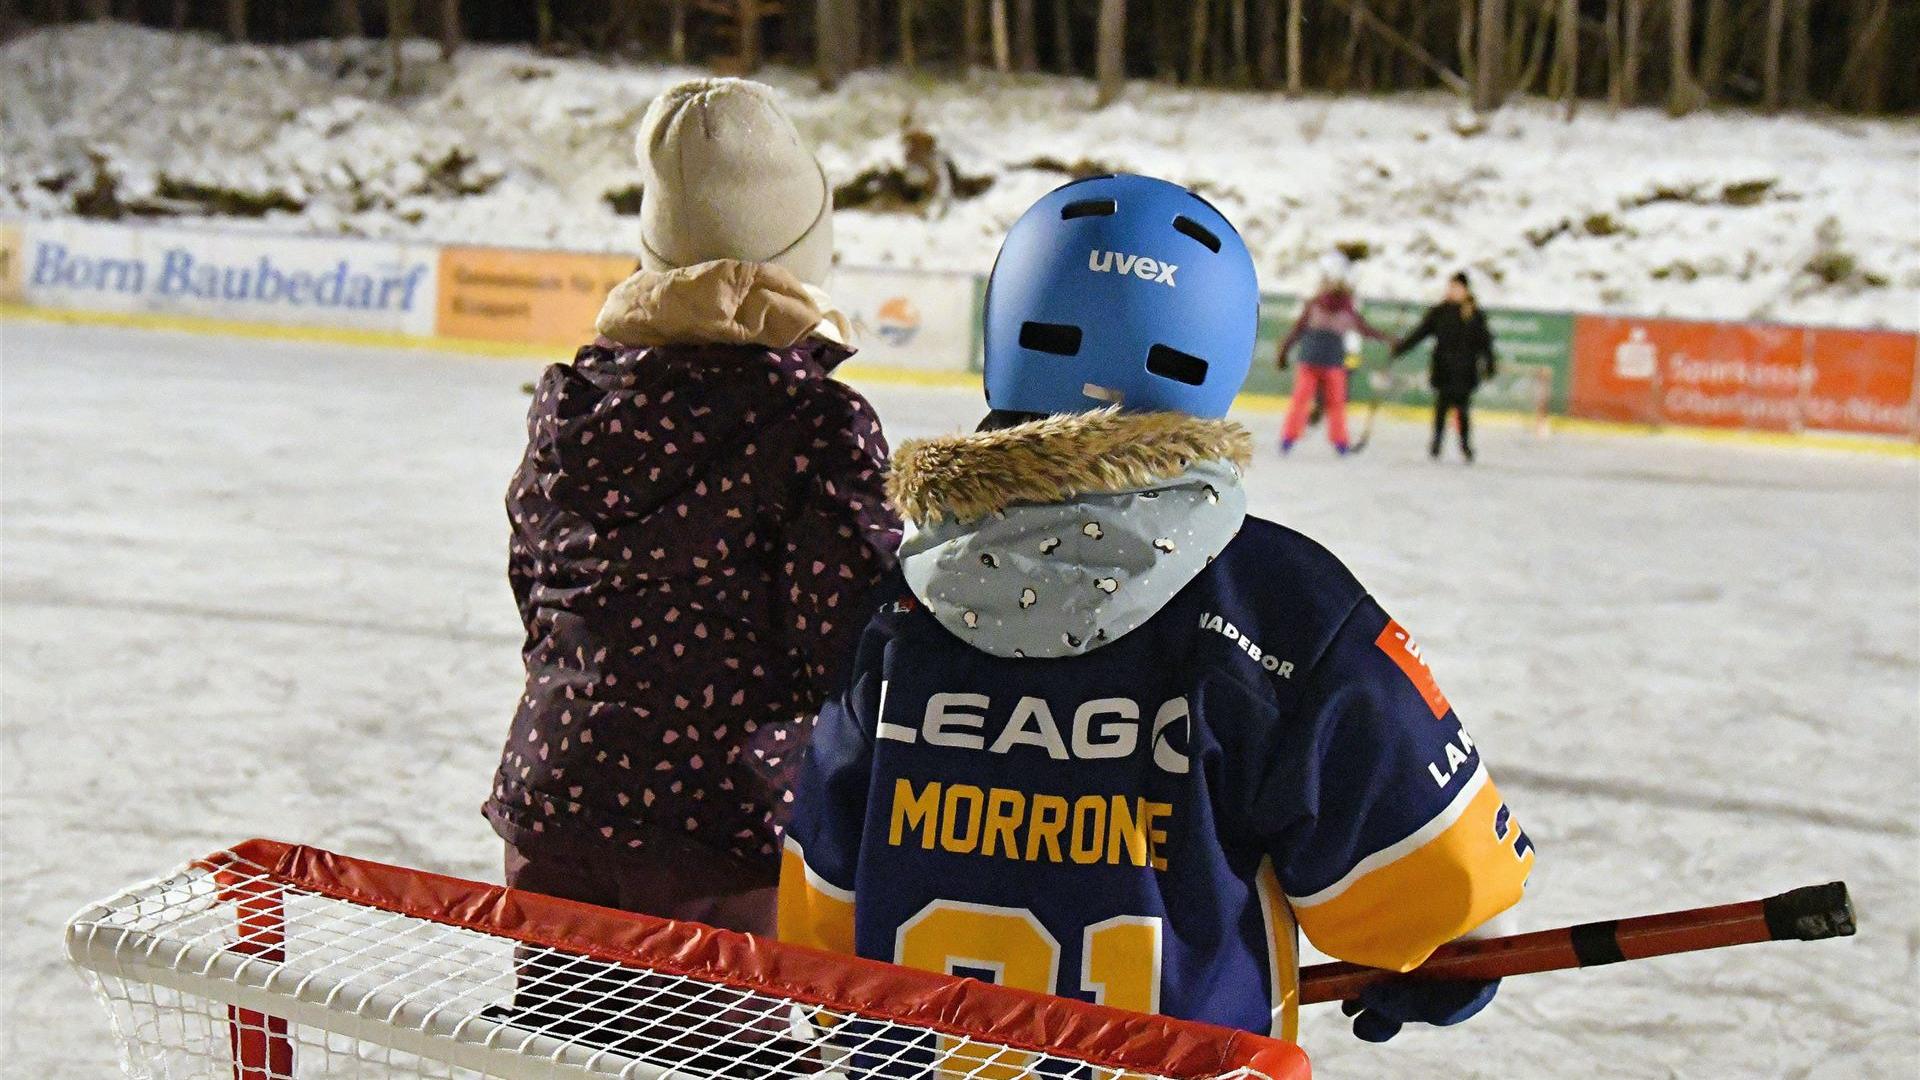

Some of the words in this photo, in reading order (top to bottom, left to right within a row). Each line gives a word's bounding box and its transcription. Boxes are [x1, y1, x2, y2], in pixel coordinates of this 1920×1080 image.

[31, 241, 145, 294] Born
[159, 247, 428, 312] Baubedarf
[1088, 249, 1178, 287] uvex
[888, 778, 1173, 871] MORRONE
